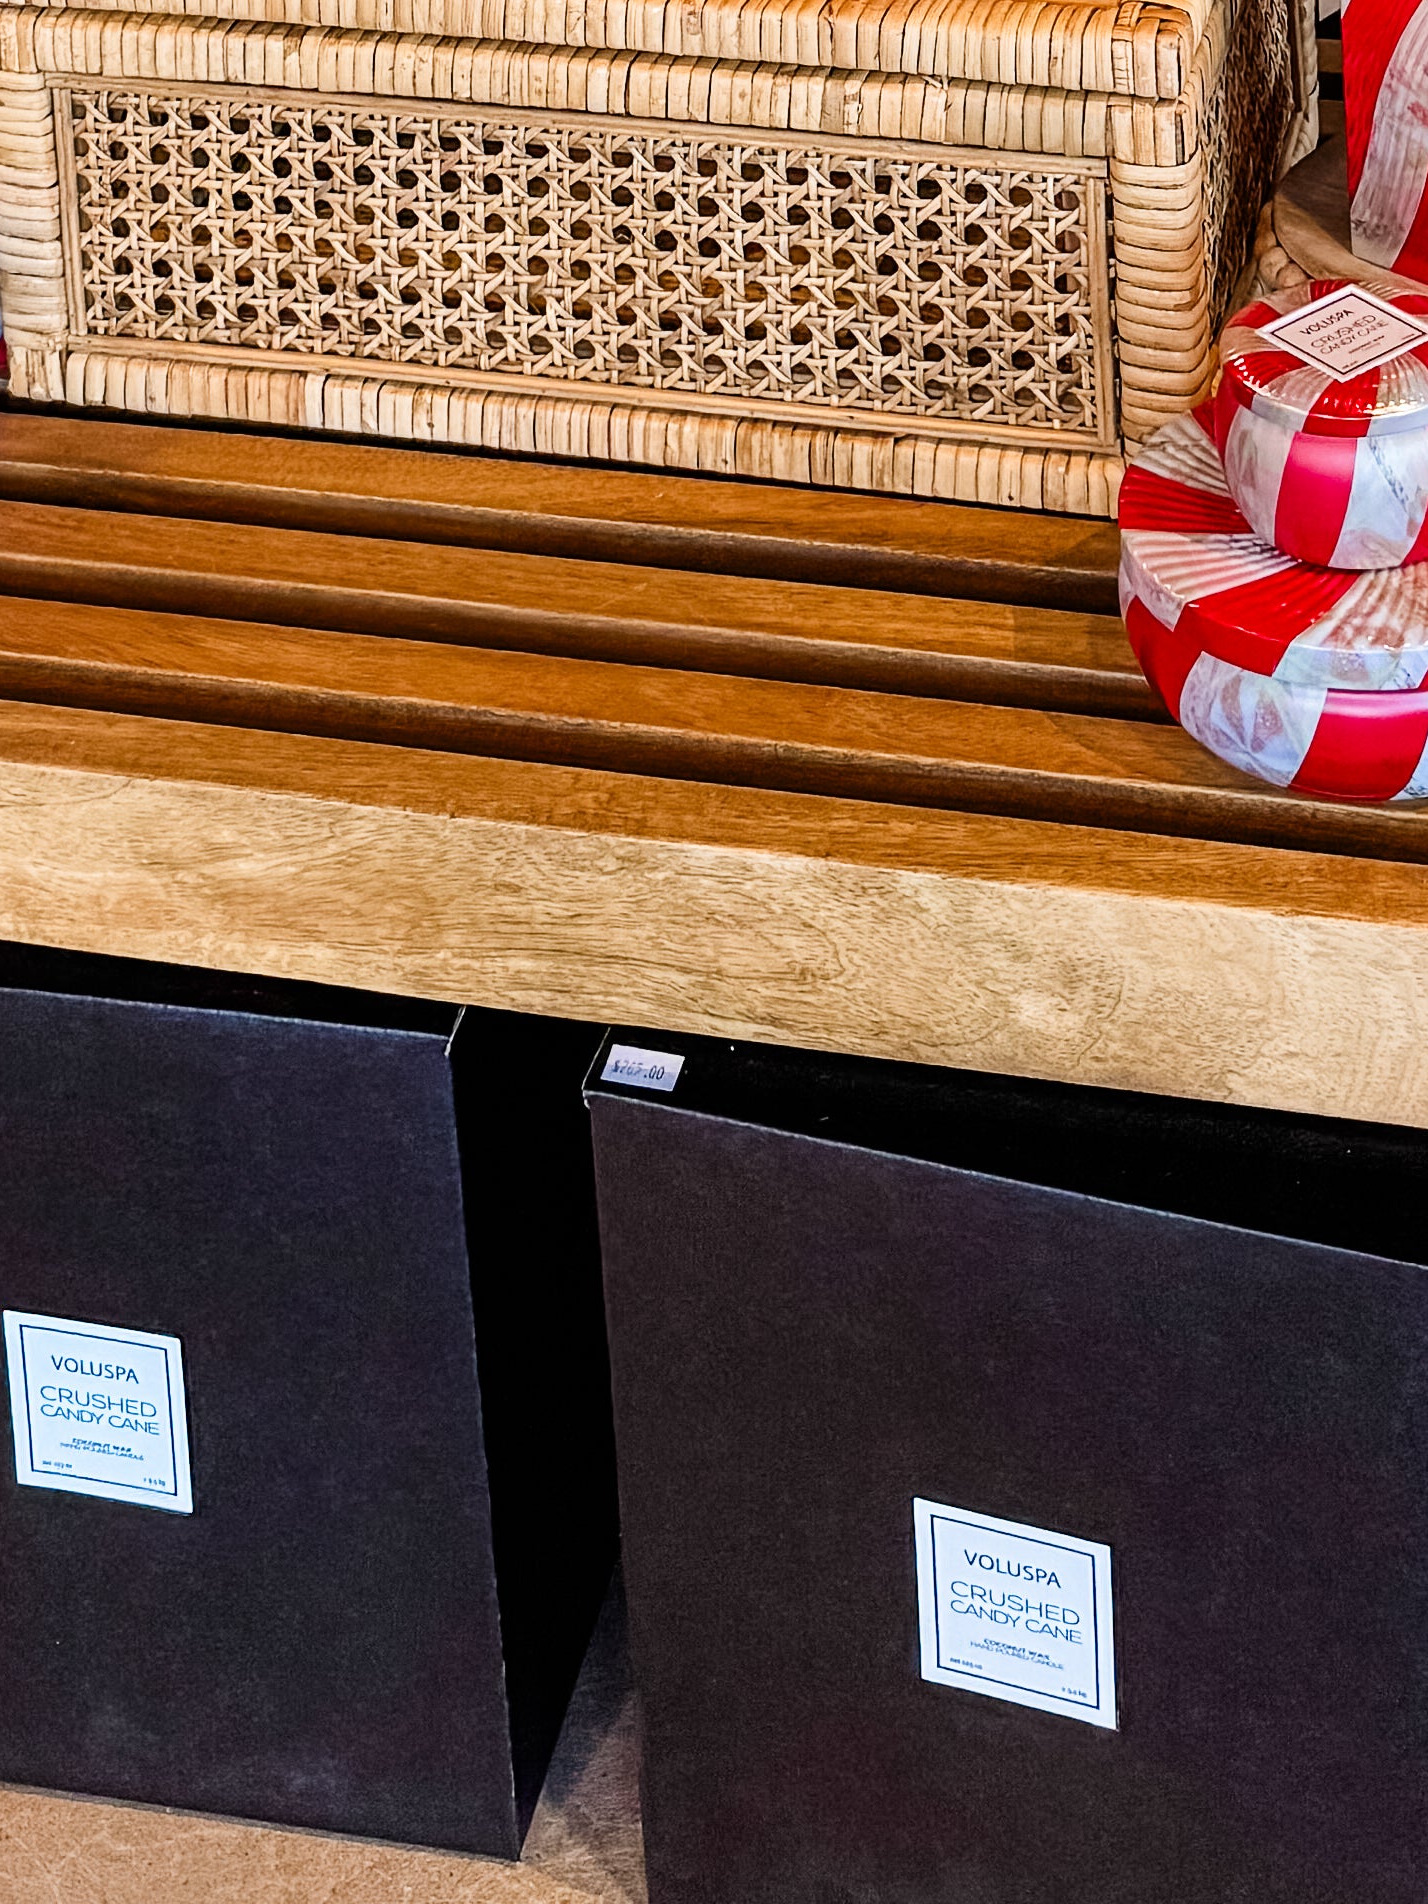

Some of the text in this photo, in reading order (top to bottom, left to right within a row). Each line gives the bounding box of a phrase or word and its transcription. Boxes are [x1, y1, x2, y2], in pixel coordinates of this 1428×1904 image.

[1300, 309, 1354, 335] VOLUSPA
[51, 1355, 139, 1384] VOLUSPA
[41, 1386, 156, 1418] CRUSHED
[41, 1404, 160, 1435] CANDY CANE
[964, 1549, 1061, 1589] VOLUSPA
[951, 1581, 1079, 1625] CRUSHED
[951, 1600, 1083, 1644] CANDY CANE
